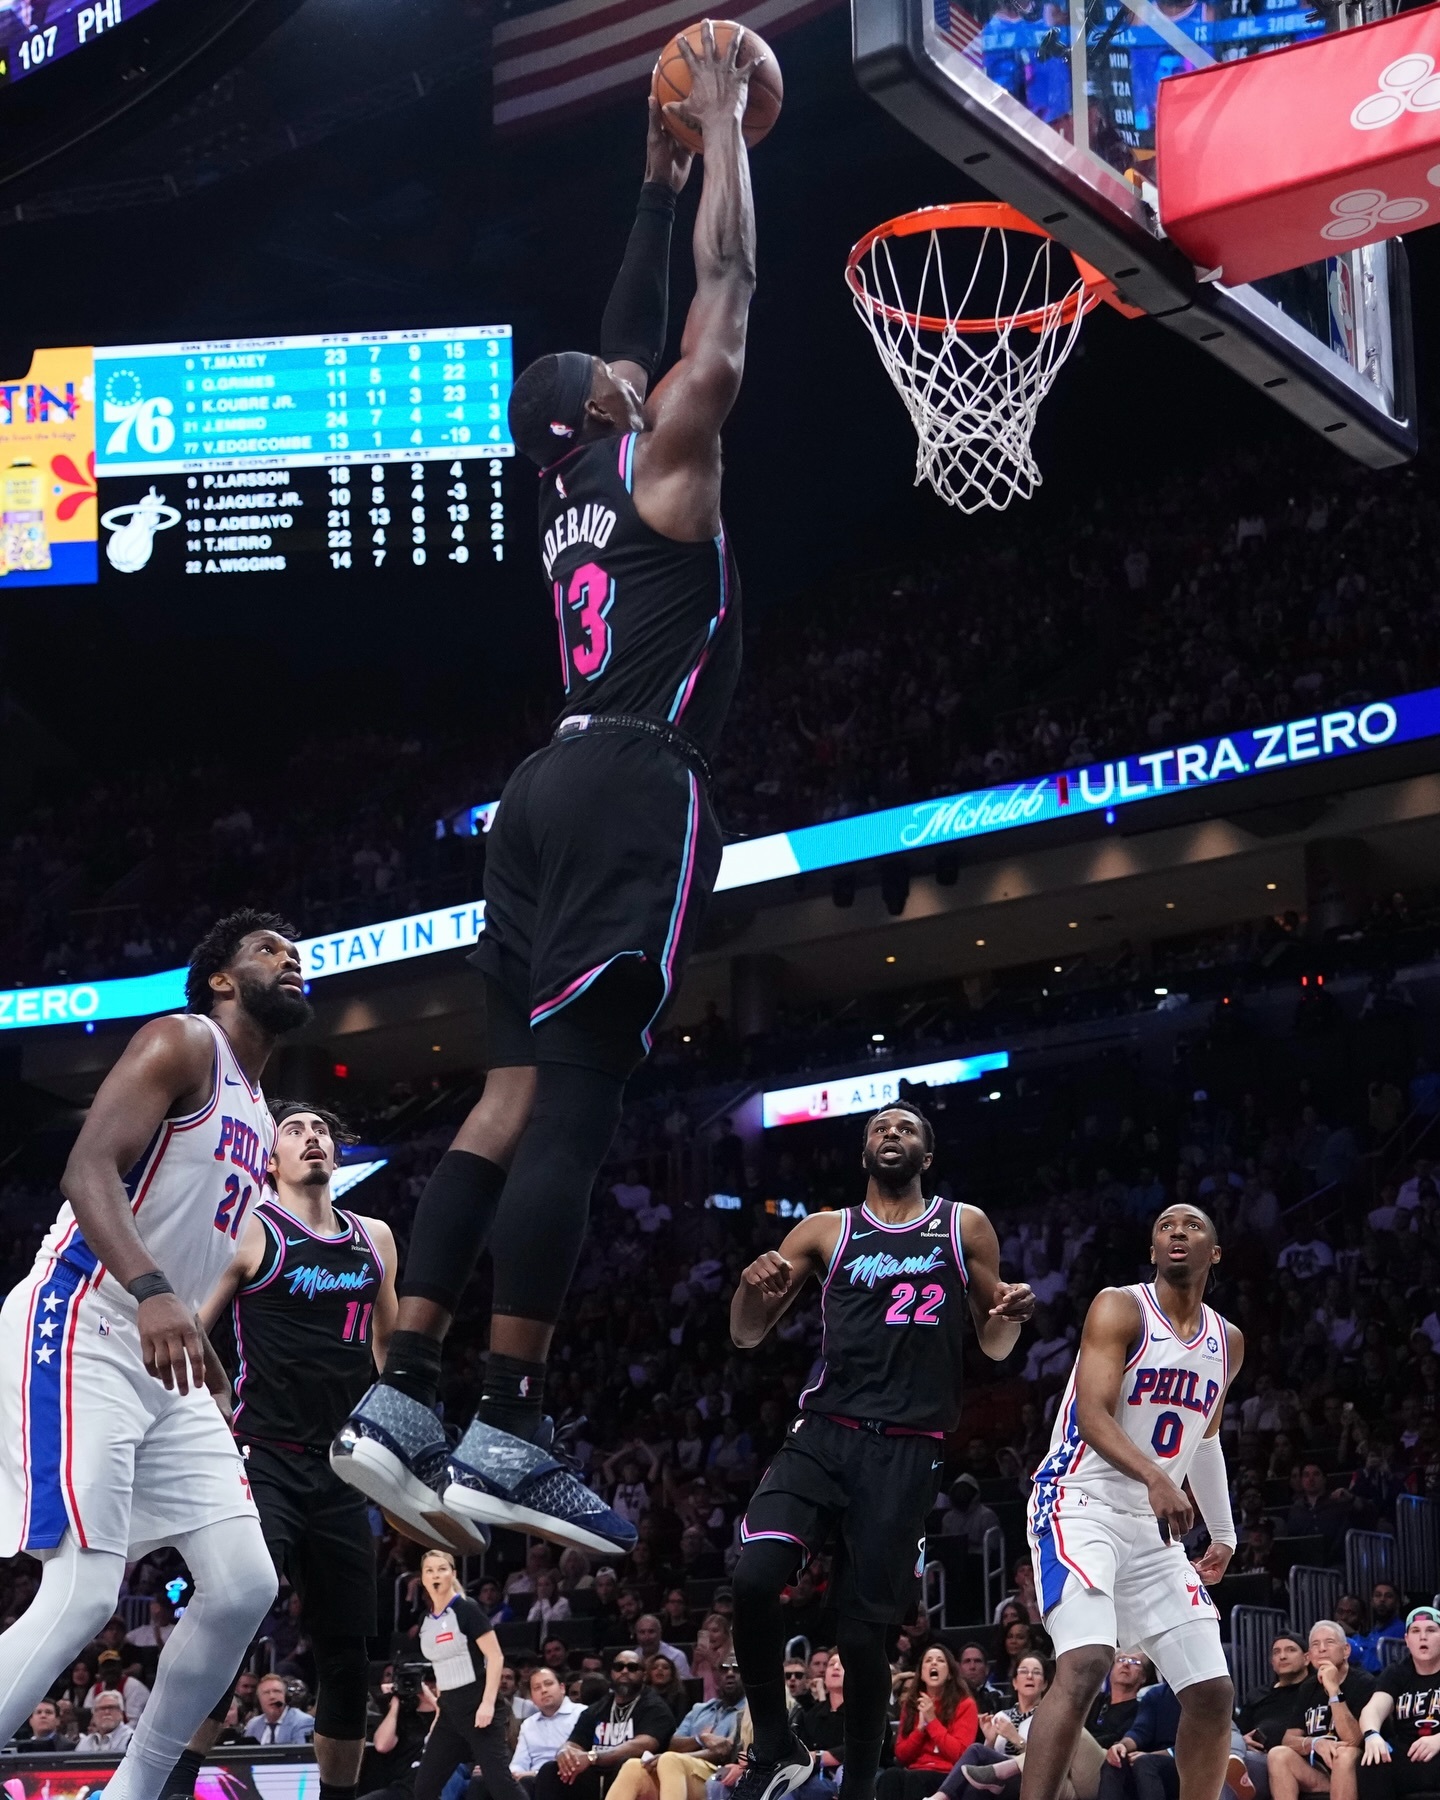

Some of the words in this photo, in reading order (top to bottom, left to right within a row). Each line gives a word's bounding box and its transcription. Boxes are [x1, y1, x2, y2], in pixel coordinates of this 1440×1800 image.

[19, 26, 57, 69] 107
[78, 0, 121, 43] PHI
[201, 354, 267, 370] T.MAXEY
[324, 348, 347, 366] 23
[368, 346, 381, 363] 7
[408, 344, 422, 361] 9
[443, 342, 465, 359] 15
[487, 340, 499, 357] 3
[327, 369, 346, 386] 11
[369, 367, 382, 384] 5
[409, 365, 421, 382] 4
[443, 363, 466, 380] 22
[489, 361, 499, 379] 1
[327, 391, 347, 408] 11
[366, 389, 386, 405] 11
[409, 387, 422, 404] 3
[443, 384, 466, 402] 23
[489, 383, 499, 400] 1
[103, 396, 176, 454] 76
[326, 411, 348, 428] 24
[370, 409, 382, 426] 7
[410, 407, 422, 424] 4
[446, 405, 465, 421] -4
[488, 403, 501, 420] 3
[184, 442, 199, 454] 77
[328, 432, 349, 449] 13
[372, 431, 382, 447] 1
[410, 428, 423, 445] 4
[441, 426, 471, 443] -19
[488, 424, 501, 441] 4
[203, 471, 290, 489] P.LARSSON
[328, 466, 350, 484] 18
[371, 464, 385, 483] 8
[411, 463, 424, 480] 2
[450, 461, 463, 478] 4
[489, 459, 503, 476] 2
[186, 498, 200, 510] 11
[203, 492, 277, 511] J.JAQUEZ
[278, 491, 304, 507] JR.
[328, 487, 351, 506] 10
[371, 486, 385, 504] 5
[411, 484, 425, 502] 4
[446, 482, 467, 500] -3
[491, 480, 502, 498] 1
[203, 513, 294, 532] B.ADEBAYO
[327, 509, 350, 527] 21
[368, 507, 391, 526] 13
[411, 506, 425, 524] 6
[447, 504, 470, 522] 13
[490, 502, 504, 520] 2
[204, 534, 272, 552] T.HERRO
[327, 529, 352, 548] 22
[372, 528, 386, 545] 4
[412, 526, 426, 544] 3
[451, 524, 465, 542] 4
[490, 522, 504, 540] 2
[204, 555, 286, 573] A.WIGGINS
[329, 551, 352, 569] 14
[372, 549, 387, 567] 7
[412, 547, 426, 566] 0
[448, 545, 469, 563] -9
[492, 543, 504, 561] 1
[900, 779, 1049, 847] Michelob
[1079, 738, 1245, 804] ULTRA
[1253, 702, 1397, 769] ZERO
[311, 929, 385, 970] STAY
[403, 919, 433, 951] IN
[0, 986, 99, 1024] ZERO
[214, 1173, 252, 1240] 21
[284, 1263, 374, 1300] Miami
[844, 1246, 947, 1288] Miami
[885, 1283, 946, 1325] 22
[342, 1301, 373, 1344] 11
[1151, 1411, 1183, 1458] 0
[1186, 1583, 1211, 1606] 76
